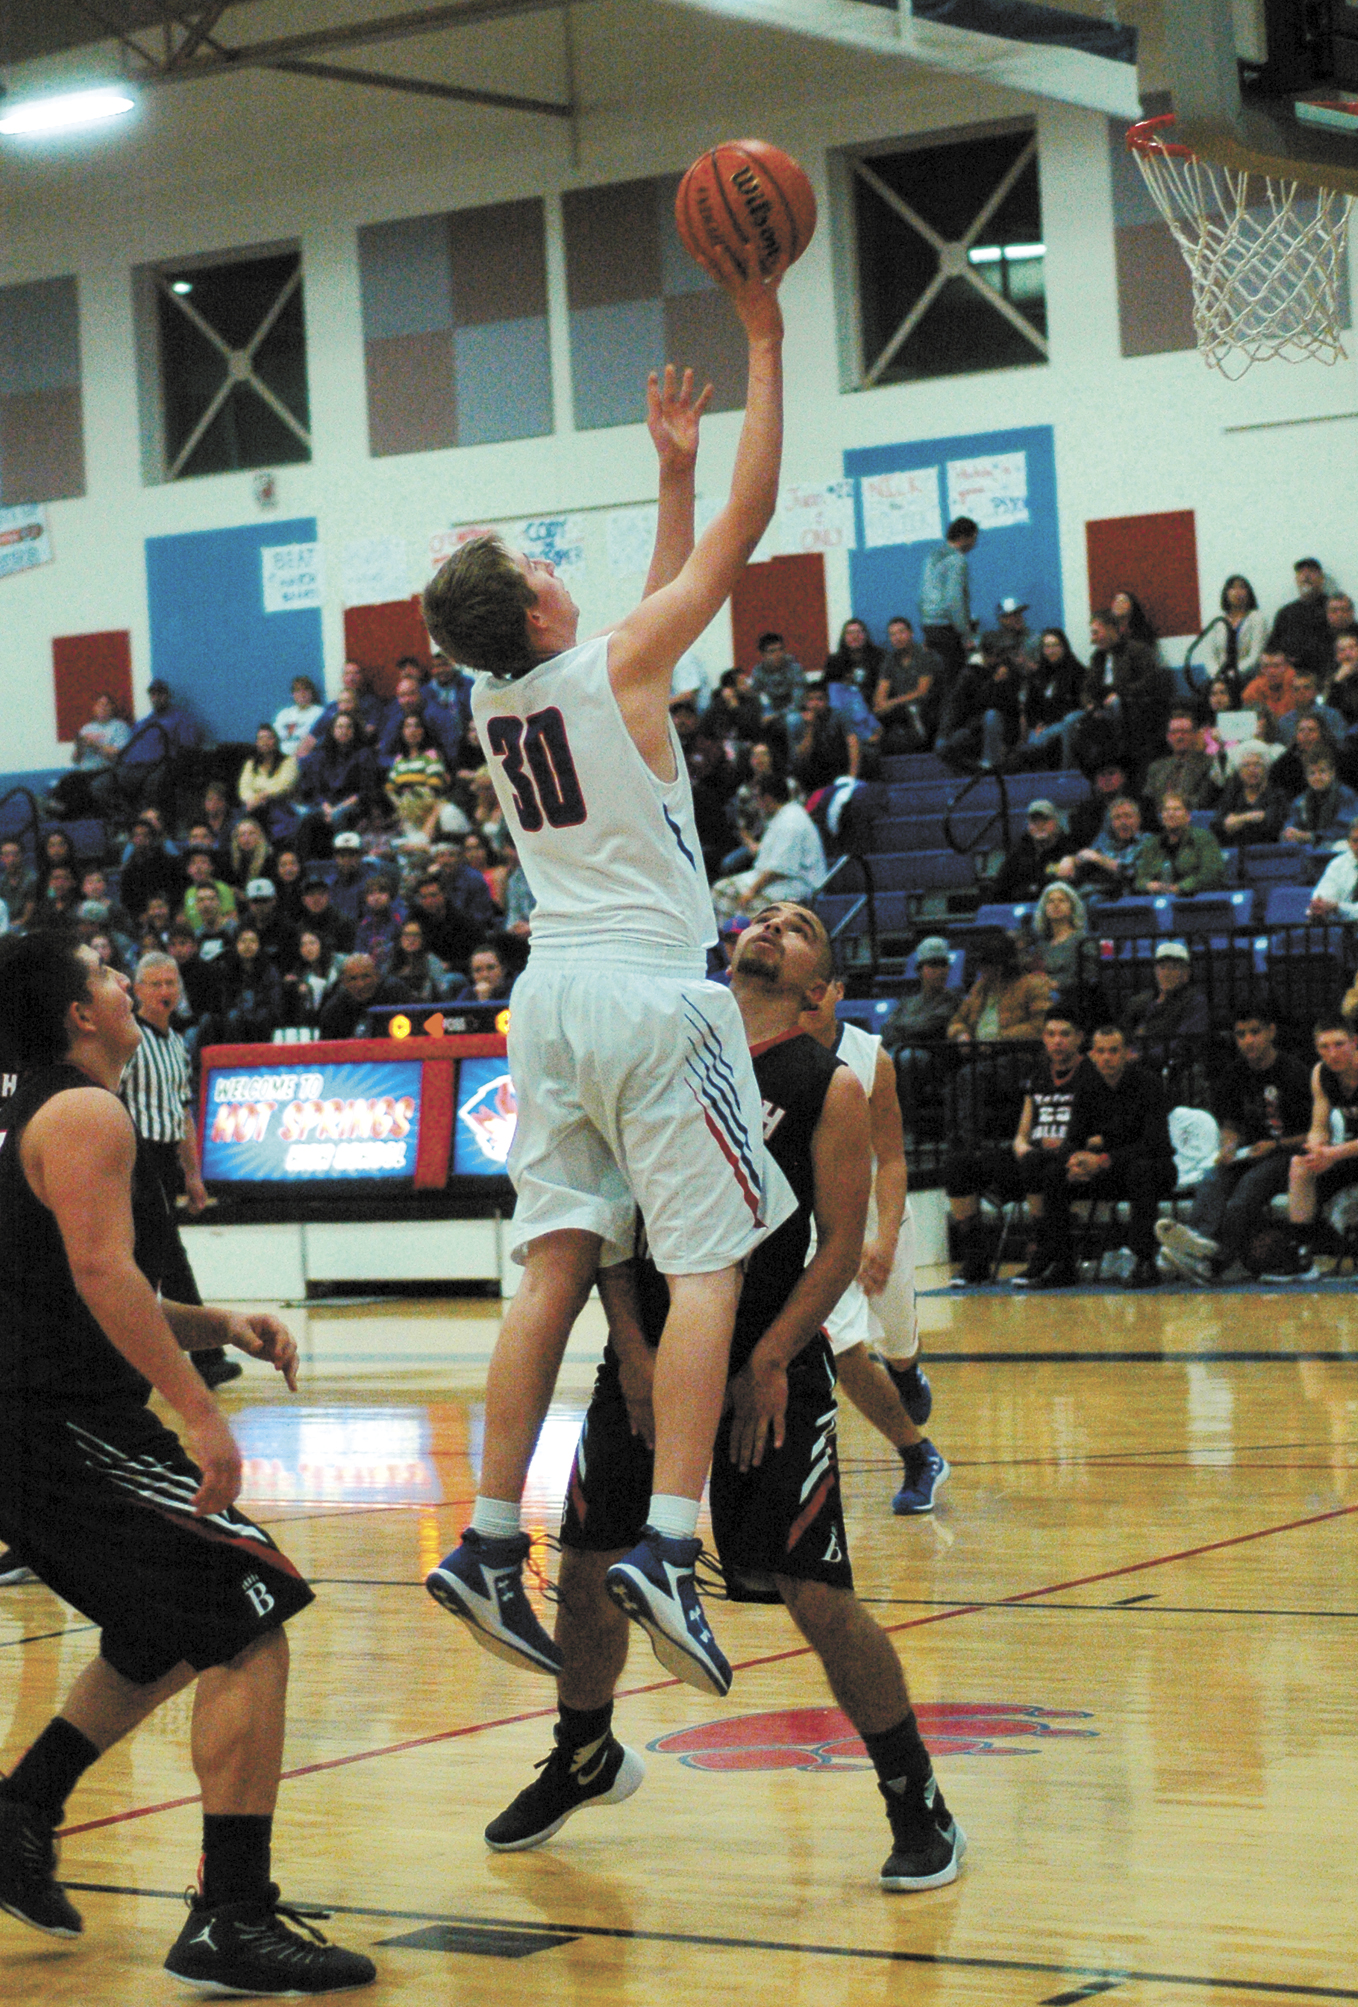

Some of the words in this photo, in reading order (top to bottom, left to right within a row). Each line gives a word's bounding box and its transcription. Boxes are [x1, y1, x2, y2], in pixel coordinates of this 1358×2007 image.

[729, 166, 781, 257] Wilson
[487, 706, 587, 832] 30
[215, 1075, 297, 1101] WELCOME
[299, 1074, 323, 1100] TO
[212, 1101, 278, 1142] HOT
[280, 1097, 415, 1141] SPRINGS
[245, 1582, 275, 1617] B
